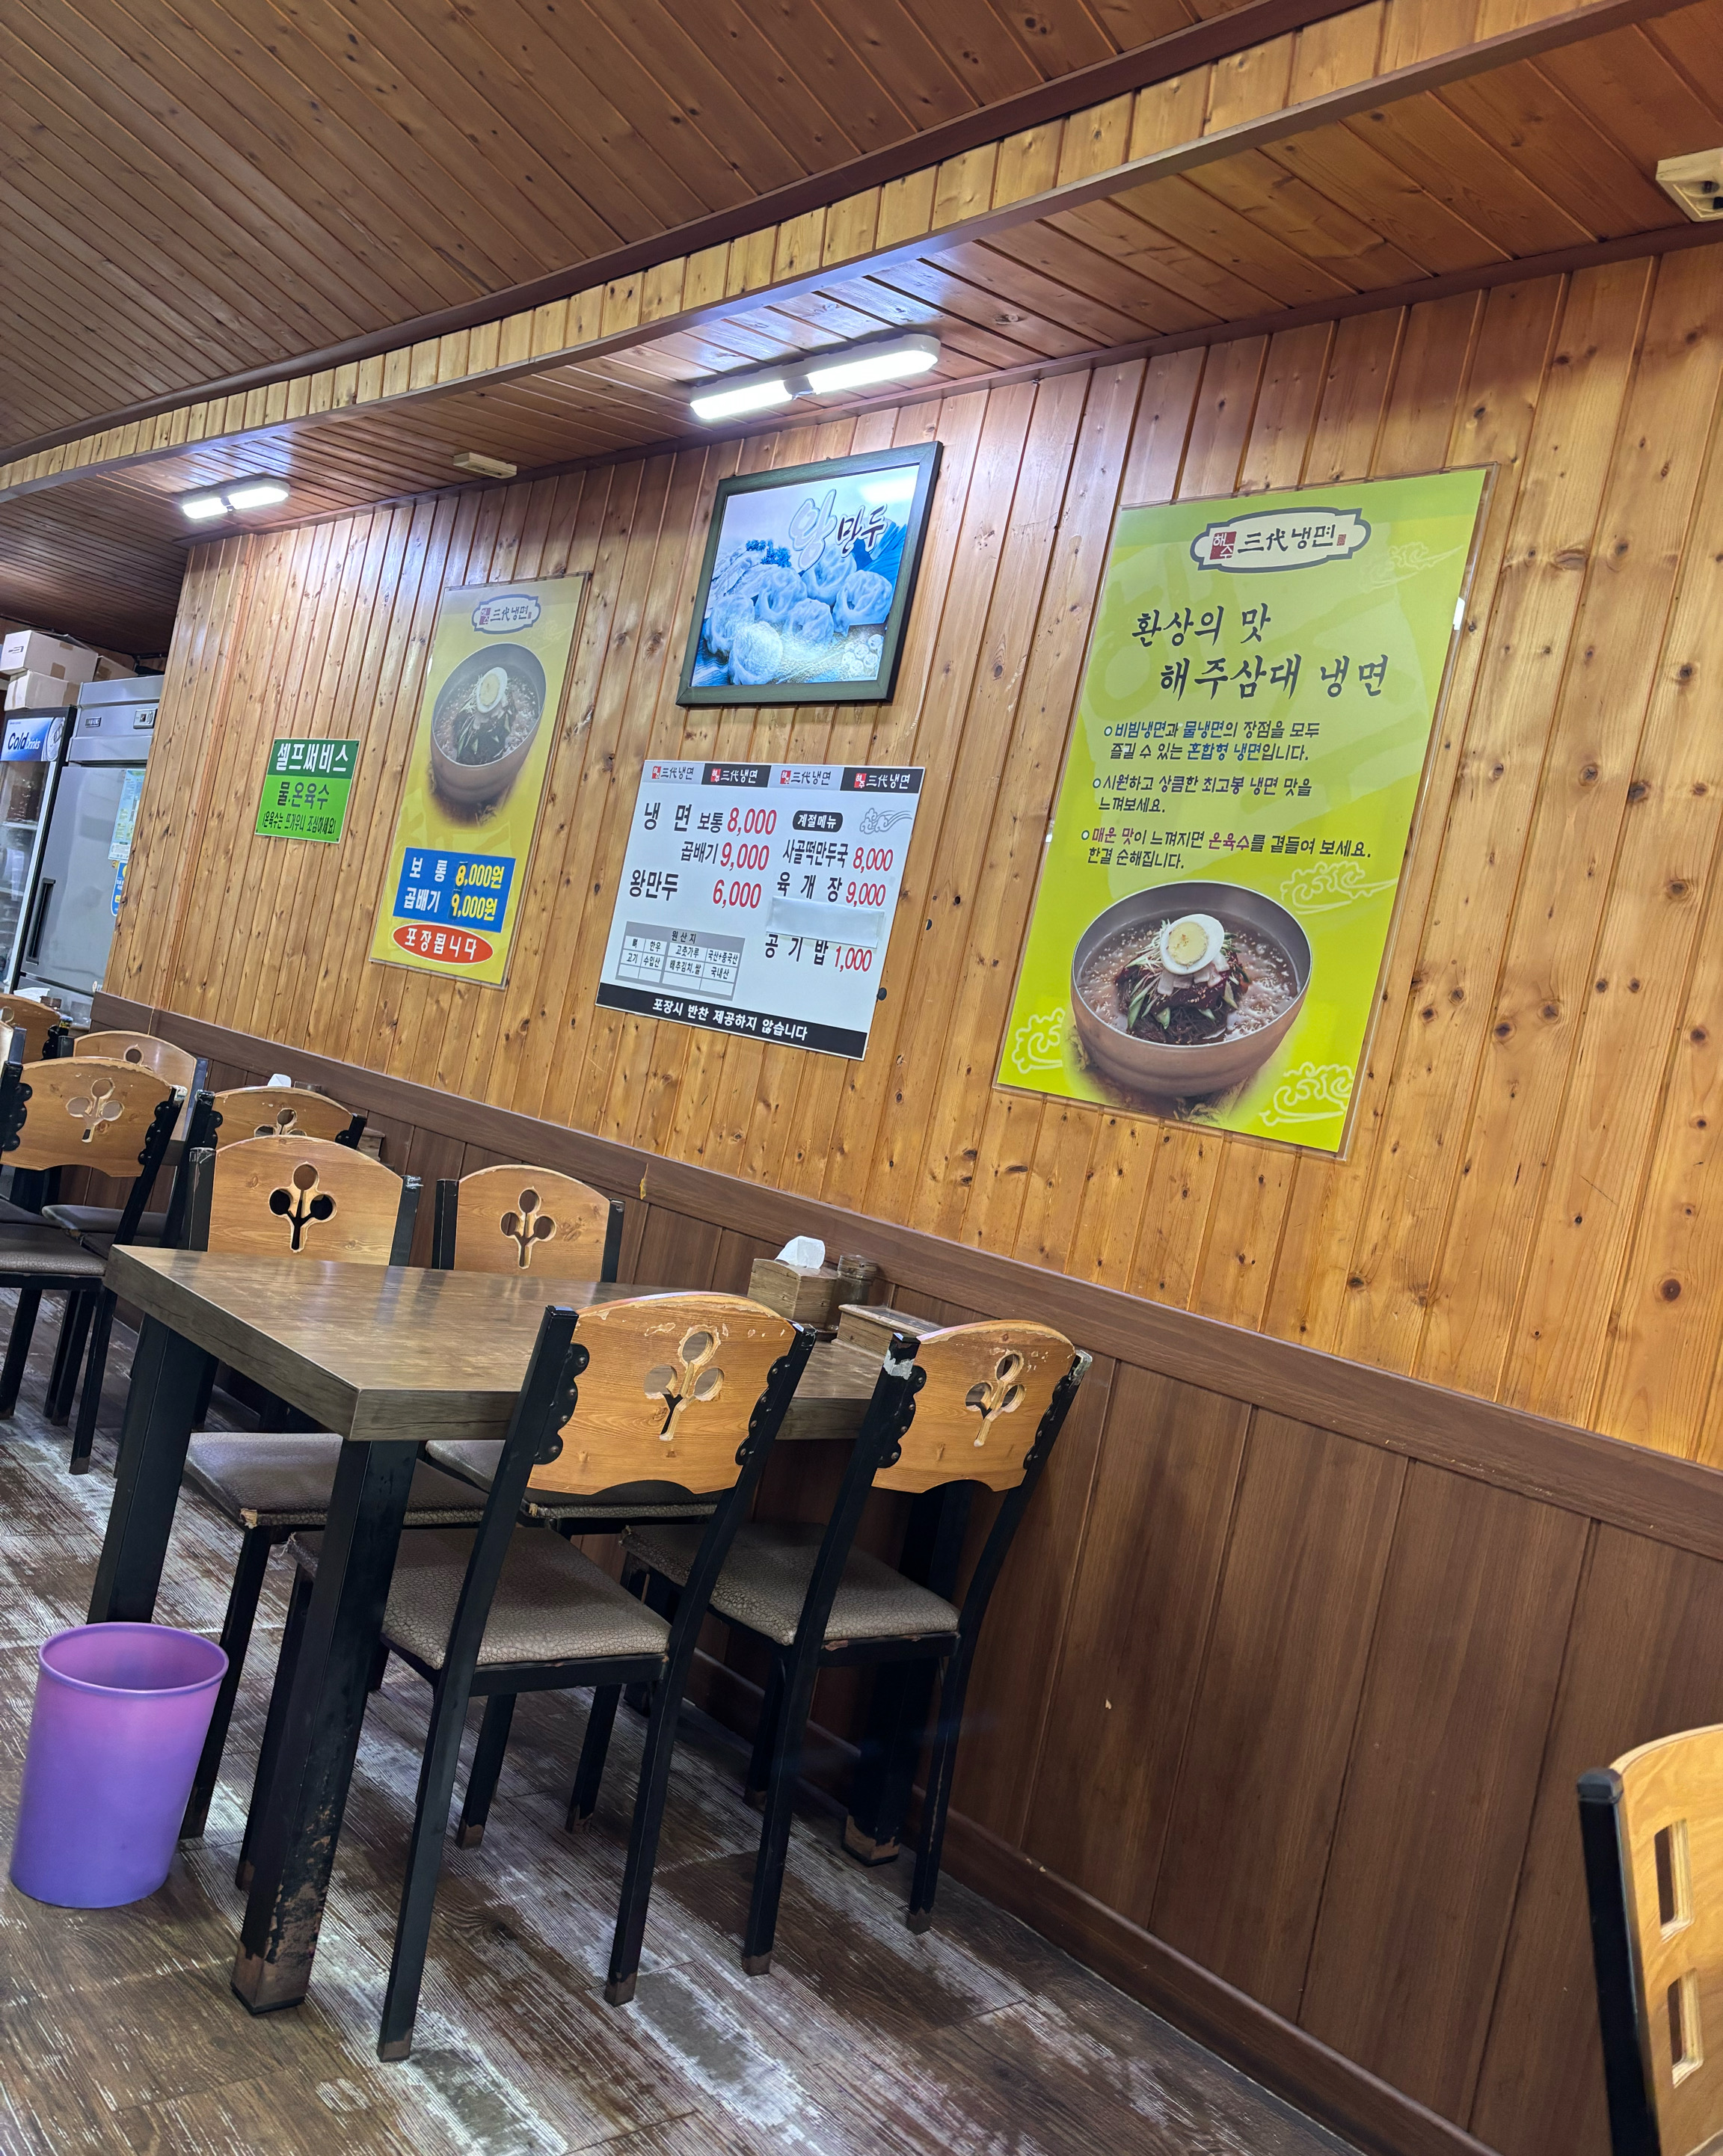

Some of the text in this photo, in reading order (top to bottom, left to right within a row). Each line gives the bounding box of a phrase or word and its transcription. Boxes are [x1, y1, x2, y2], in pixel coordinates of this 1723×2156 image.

[1131, 602, 1271, 648] 환상의 맛
[1161, 653, 1389, 701] 해주삼대 냉면
[7, 732, 29, 750] Cold
[1114, 720, 1321, 739] 비빔냉면과 물냉면의 장점을 모두
[276, 743, 349, 773] 셀프써비스
[1110, 743, 1309, 761] 즐길 수 있는 혼합형 냉면입니다.
[1103, 775, 1312, 796] 시원하고 상큼한 최고봉 냉면 맛을
[1098, 797, 1165, 814] 느껴보세요.
[697, 812, 723, 833] 보통
[727, 807, 777, 836] 8,000
[797, 814, 837, 829] 계절메뉴
[782, 838, 894, 873] 사골떡만두국 8,000
[1091, 826, 1372, 859] 매운 맛이 느껴지면 온육수를 곁들여 보세요.
[681, 841, 770, 871] 곱배기 9,000
[1087, 847, 1185, 869] 한결 순해집니다.
[455, 863, 505, 889] 8,000원
[629, 869, 762, 909] 왕만두 6,000
[403, 886, 498, 921] 곱배기 9,000원
[846, 882, 886, 907] 9,000
[405, 927, 477, 960] 포장됩니다
[650, 940, 661, 952] 한우
[675, 945, 699, 959] 고춧가루
[626, 953, 660, 968] 고기 수입산
[835, 945, 873, 972] 1,000
[710, 966, 730, 980] 국내산
[652, 998, 808, 1041] 포장시 반찬 제공하지 않습니다
